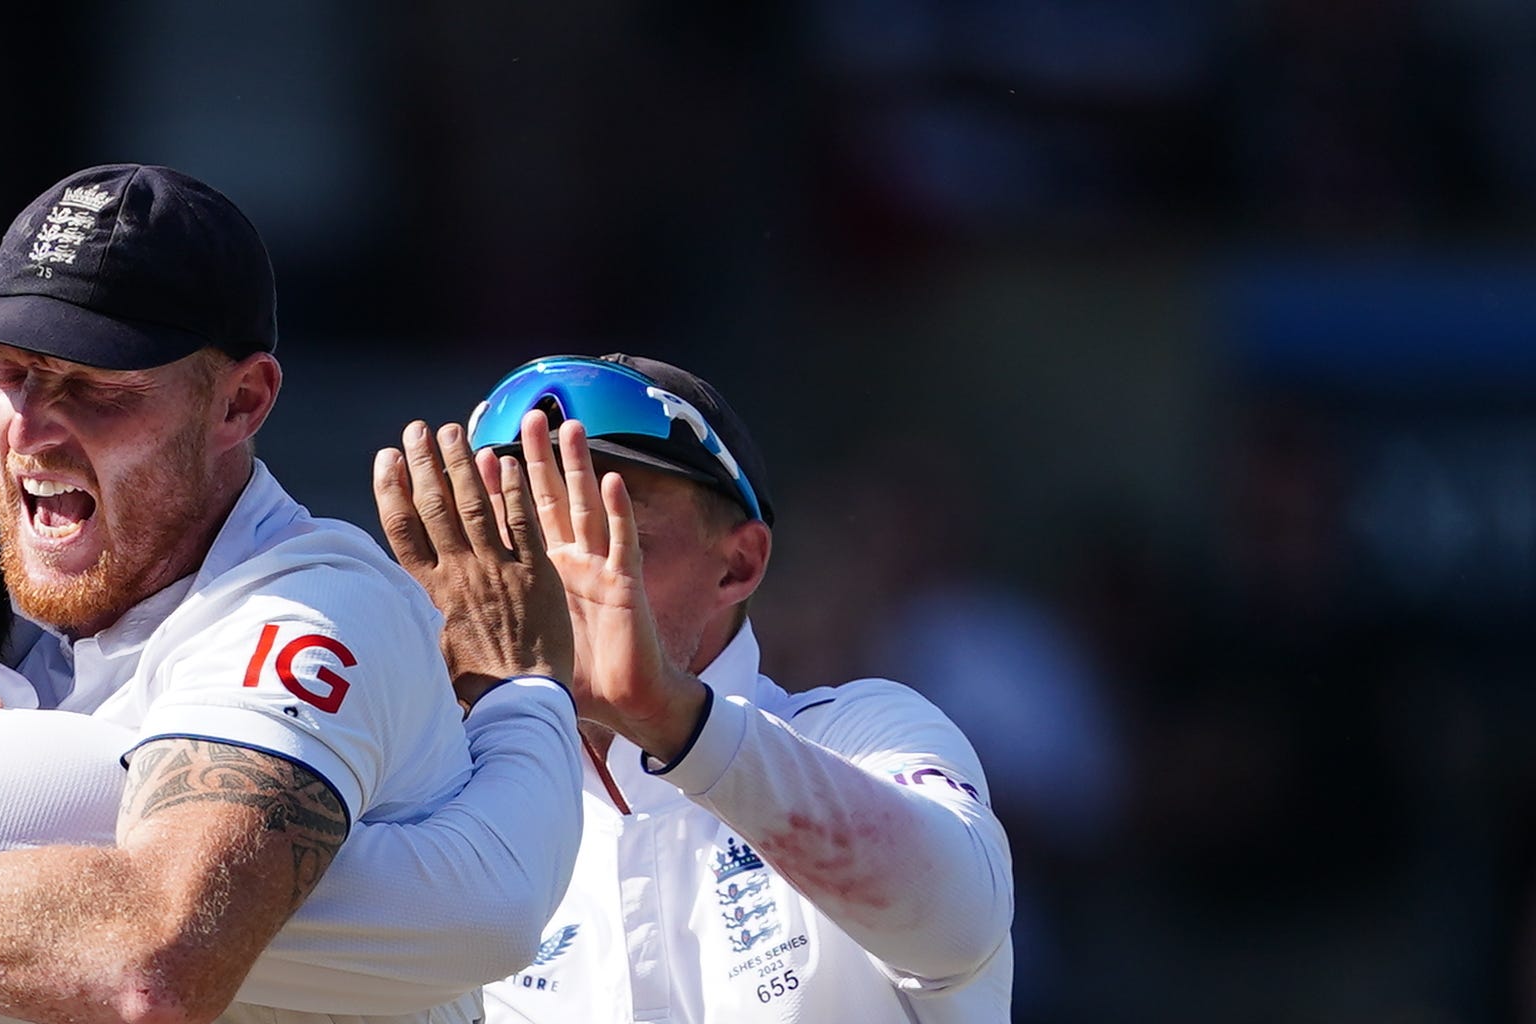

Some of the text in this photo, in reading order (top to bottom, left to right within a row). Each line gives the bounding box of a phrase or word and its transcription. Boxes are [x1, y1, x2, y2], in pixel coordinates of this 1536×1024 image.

[242, 623, 358, 714] IG
[765, 935, 808, 960] SERIES
[758, 959, 784, 978] 2023
[757, 969, 799, 1004] 655
